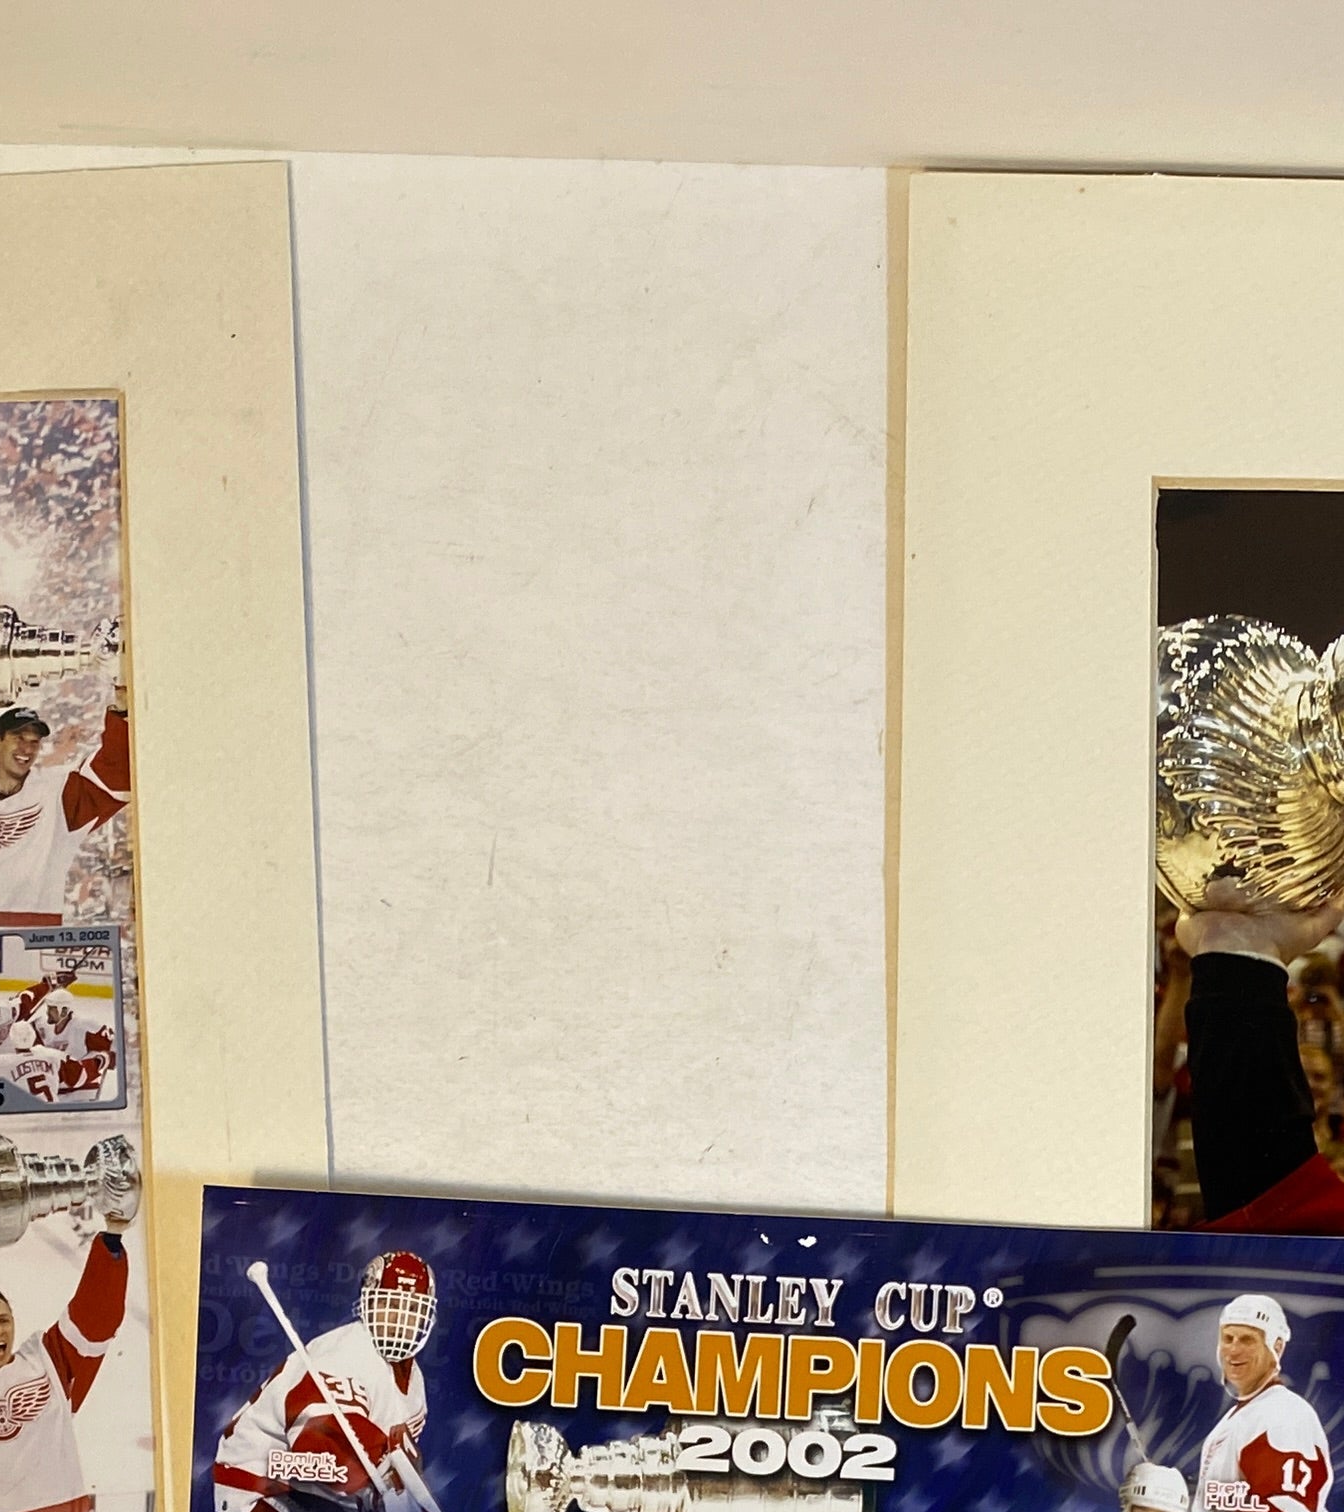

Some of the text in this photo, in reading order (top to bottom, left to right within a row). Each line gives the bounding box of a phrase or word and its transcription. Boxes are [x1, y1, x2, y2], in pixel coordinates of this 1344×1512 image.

[29, 930, 110, 943] June 13, 2002
[610, 1267, 843, 1328] STANLEY
[473, 1317, 1113, 1437] CHAMPIONS
[270, 1450, 336, 1466] Dominik
[675, 1424, 898, 1482] 2002
[268, 1463, 348, 1483] HASEK
[1205, 1481, 1250, 1495] Brett
[1204, 1494, 1270, 1512] HULL
